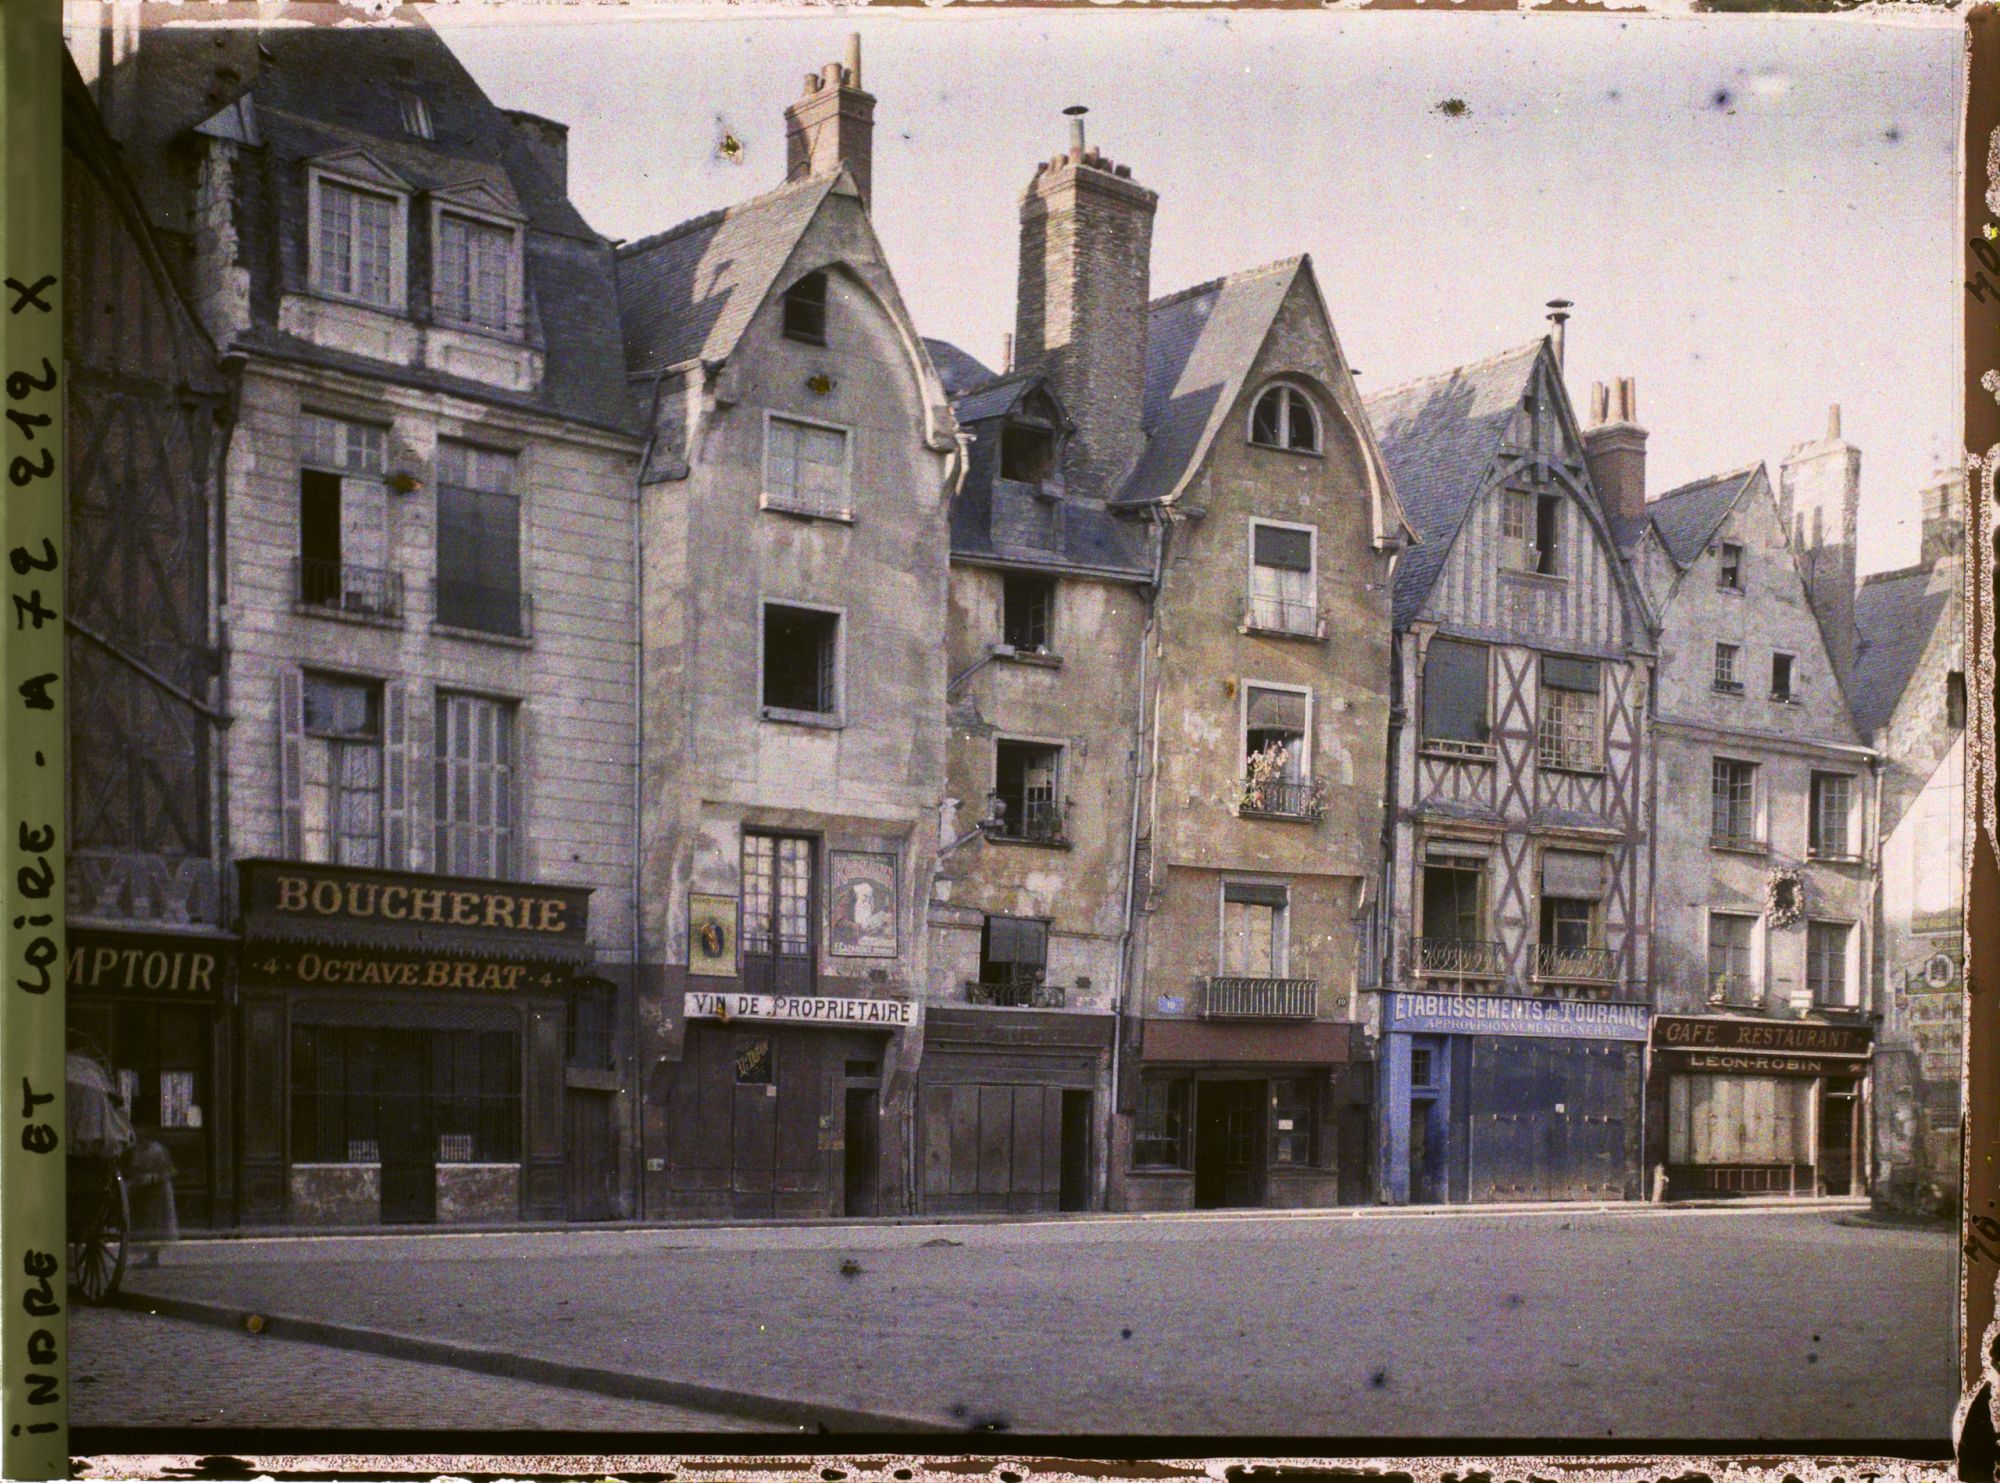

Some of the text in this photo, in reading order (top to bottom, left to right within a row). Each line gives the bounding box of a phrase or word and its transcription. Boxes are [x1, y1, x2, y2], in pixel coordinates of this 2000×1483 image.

[3, 275, 58, 315] X
[6, 357, 57, 486] 212
[10, 537, 58, 630] 72
[277, 876, 568, 932] BOUCHERIE
[65, 946, 216, 992] MPTOIR
[298, 953, 419, 986] OCTAVE
[425, 960, 527, 989] BRAT
[693, 993, 910, 1022] VIN DE PROPRIETAIRE
[1545, 1004, 1559, 1021] de
[1560, 1001, 1647, 1031] TOURAINE
[1736, 1026, 1850, 1048] RESTAURANT
[22, 1076, 58, 1154] ET
